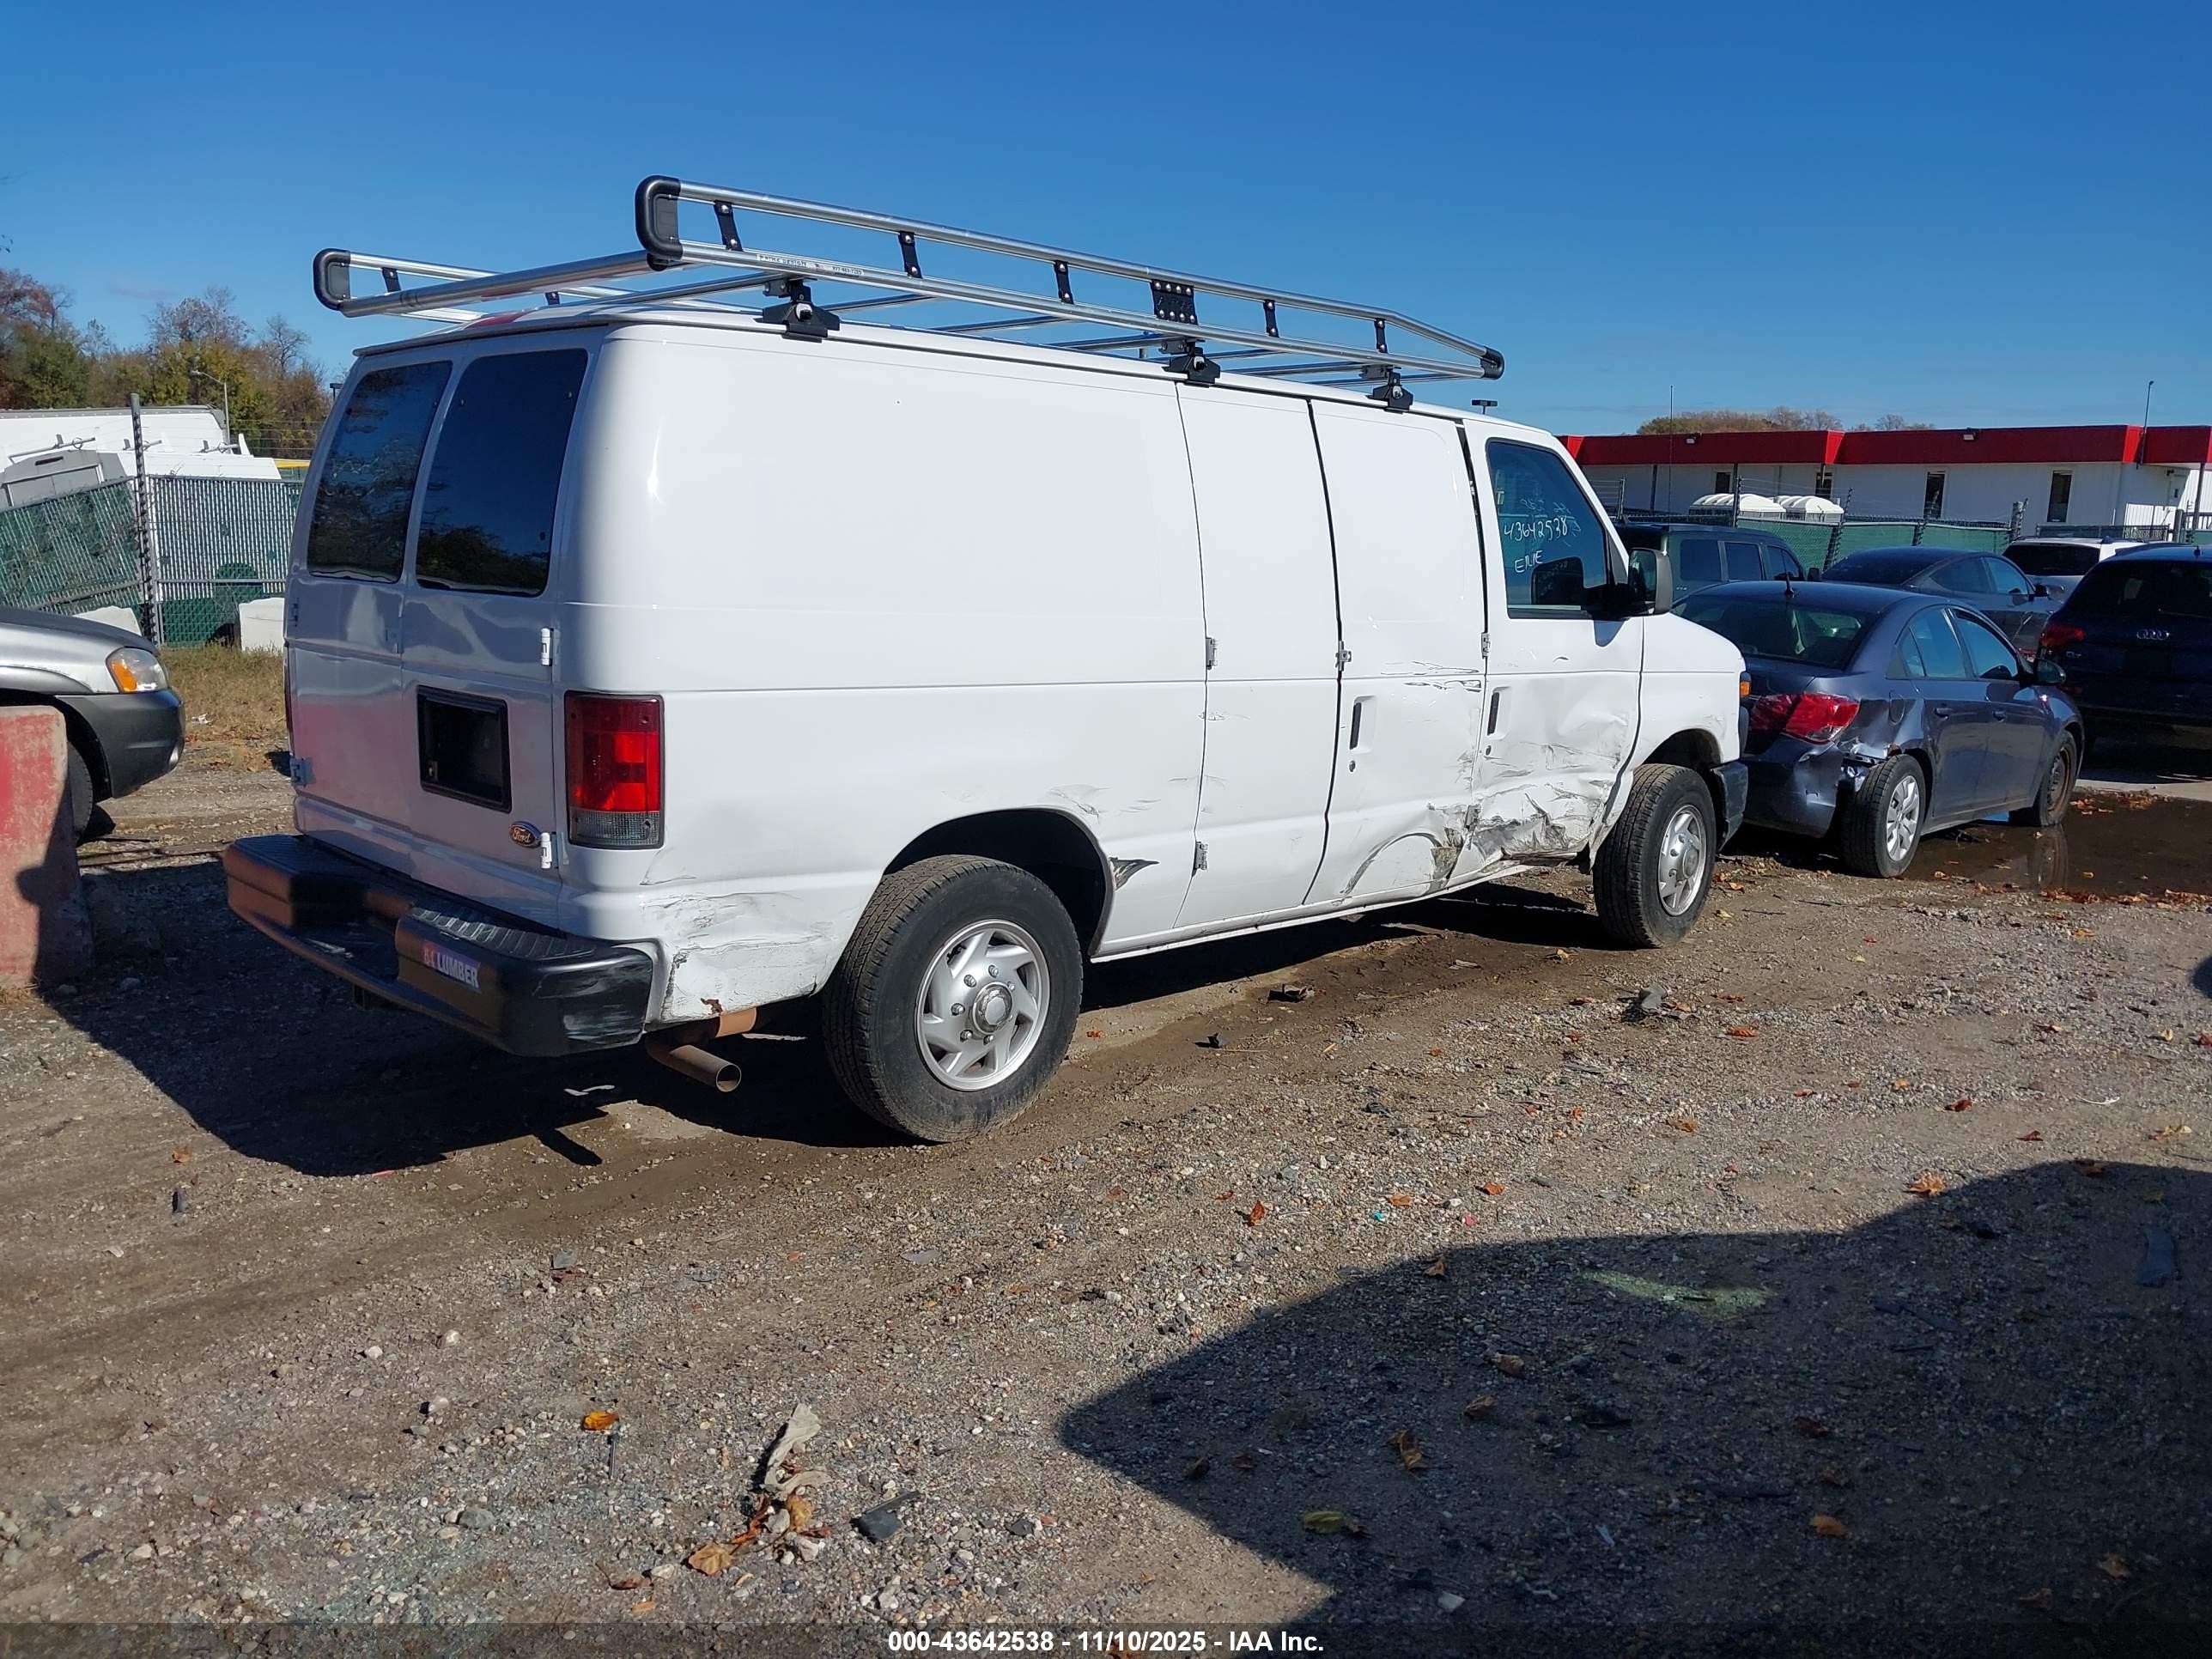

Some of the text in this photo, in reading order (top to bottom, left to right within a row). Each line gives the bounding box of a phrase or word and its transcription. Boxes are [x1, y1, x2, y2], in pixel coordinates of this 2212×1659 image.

[1504, 514, 1569, 542] 43642538
[512, 826, 532, 843] Ford
[436, 951, 480, 989] LUMBER
